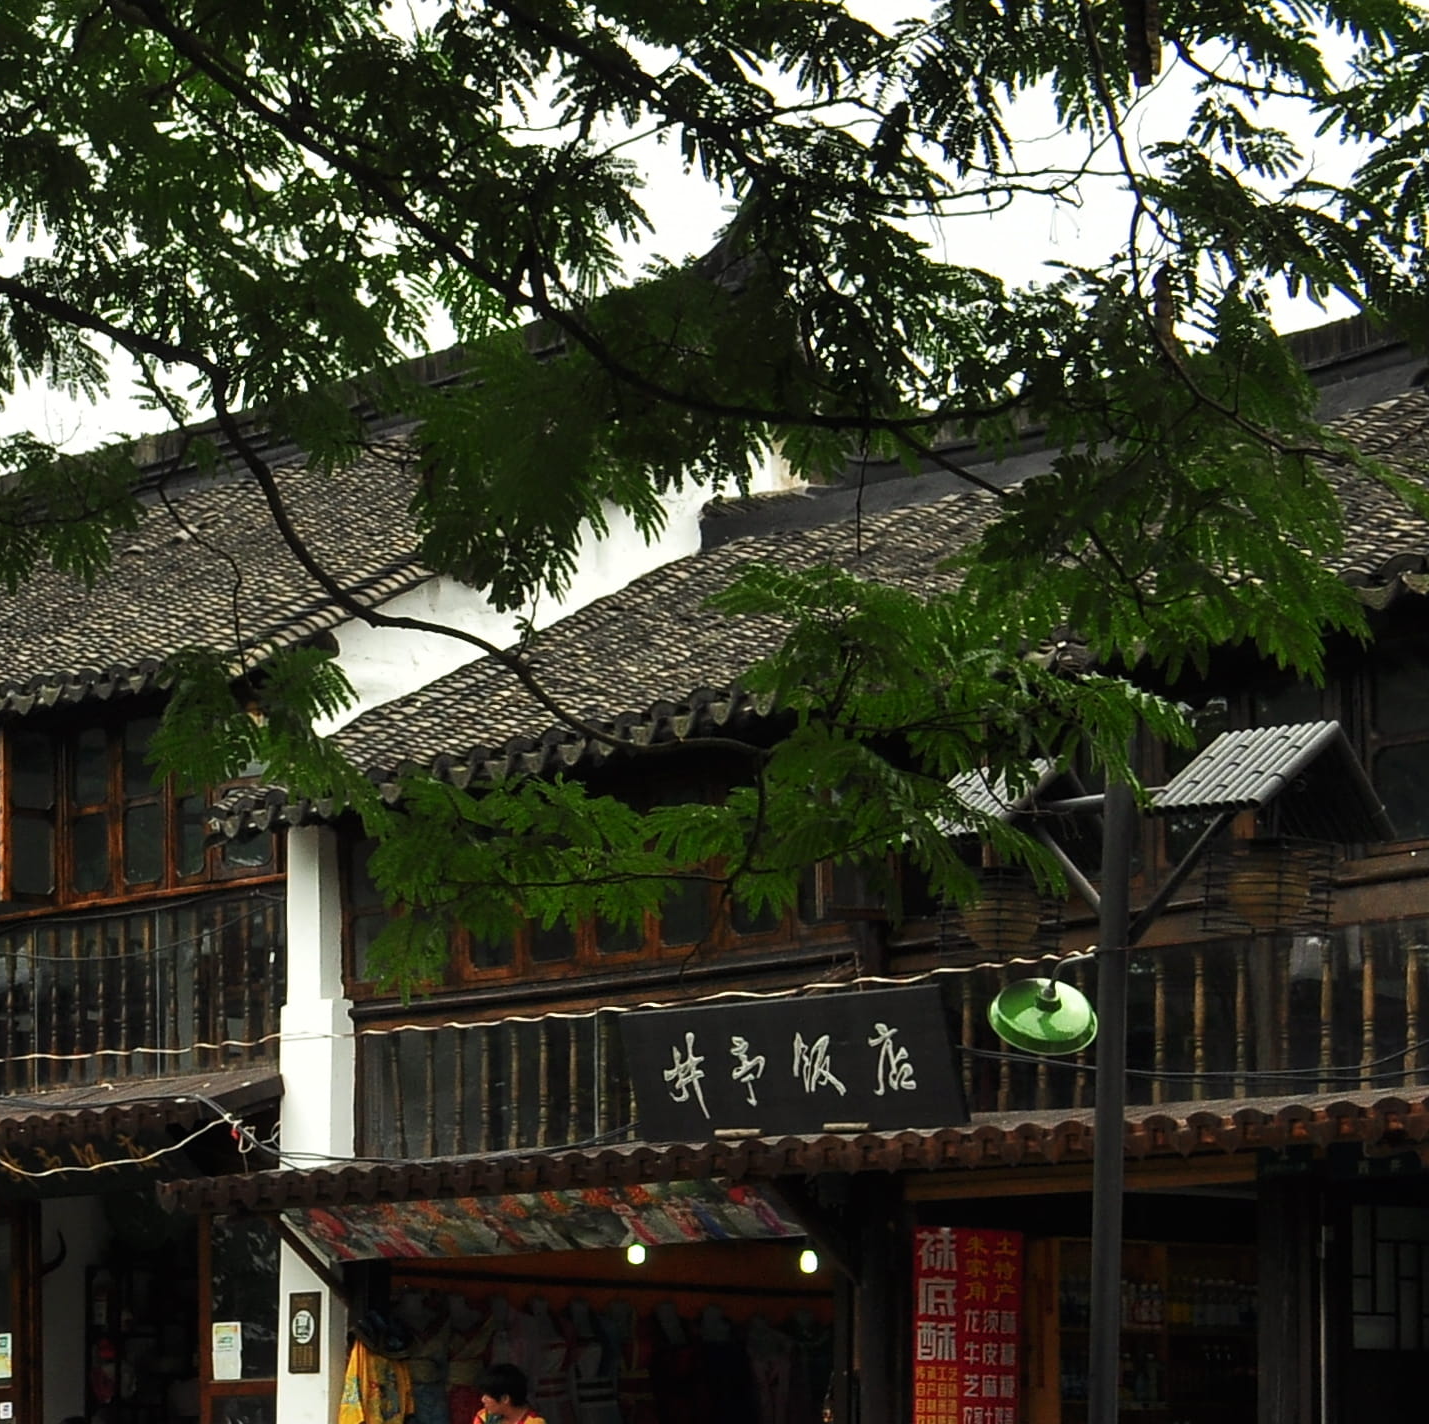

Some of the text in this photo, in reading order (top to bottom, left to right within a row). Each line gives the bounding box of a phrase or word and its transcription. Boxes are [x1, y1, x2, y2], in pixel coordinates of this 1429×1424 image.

[664, 1023, 916, 1119] 井亭饭店
[916, 1227, 958, 1361] 袜底酥
[993, 1236, 1017, 1301] 土特产
